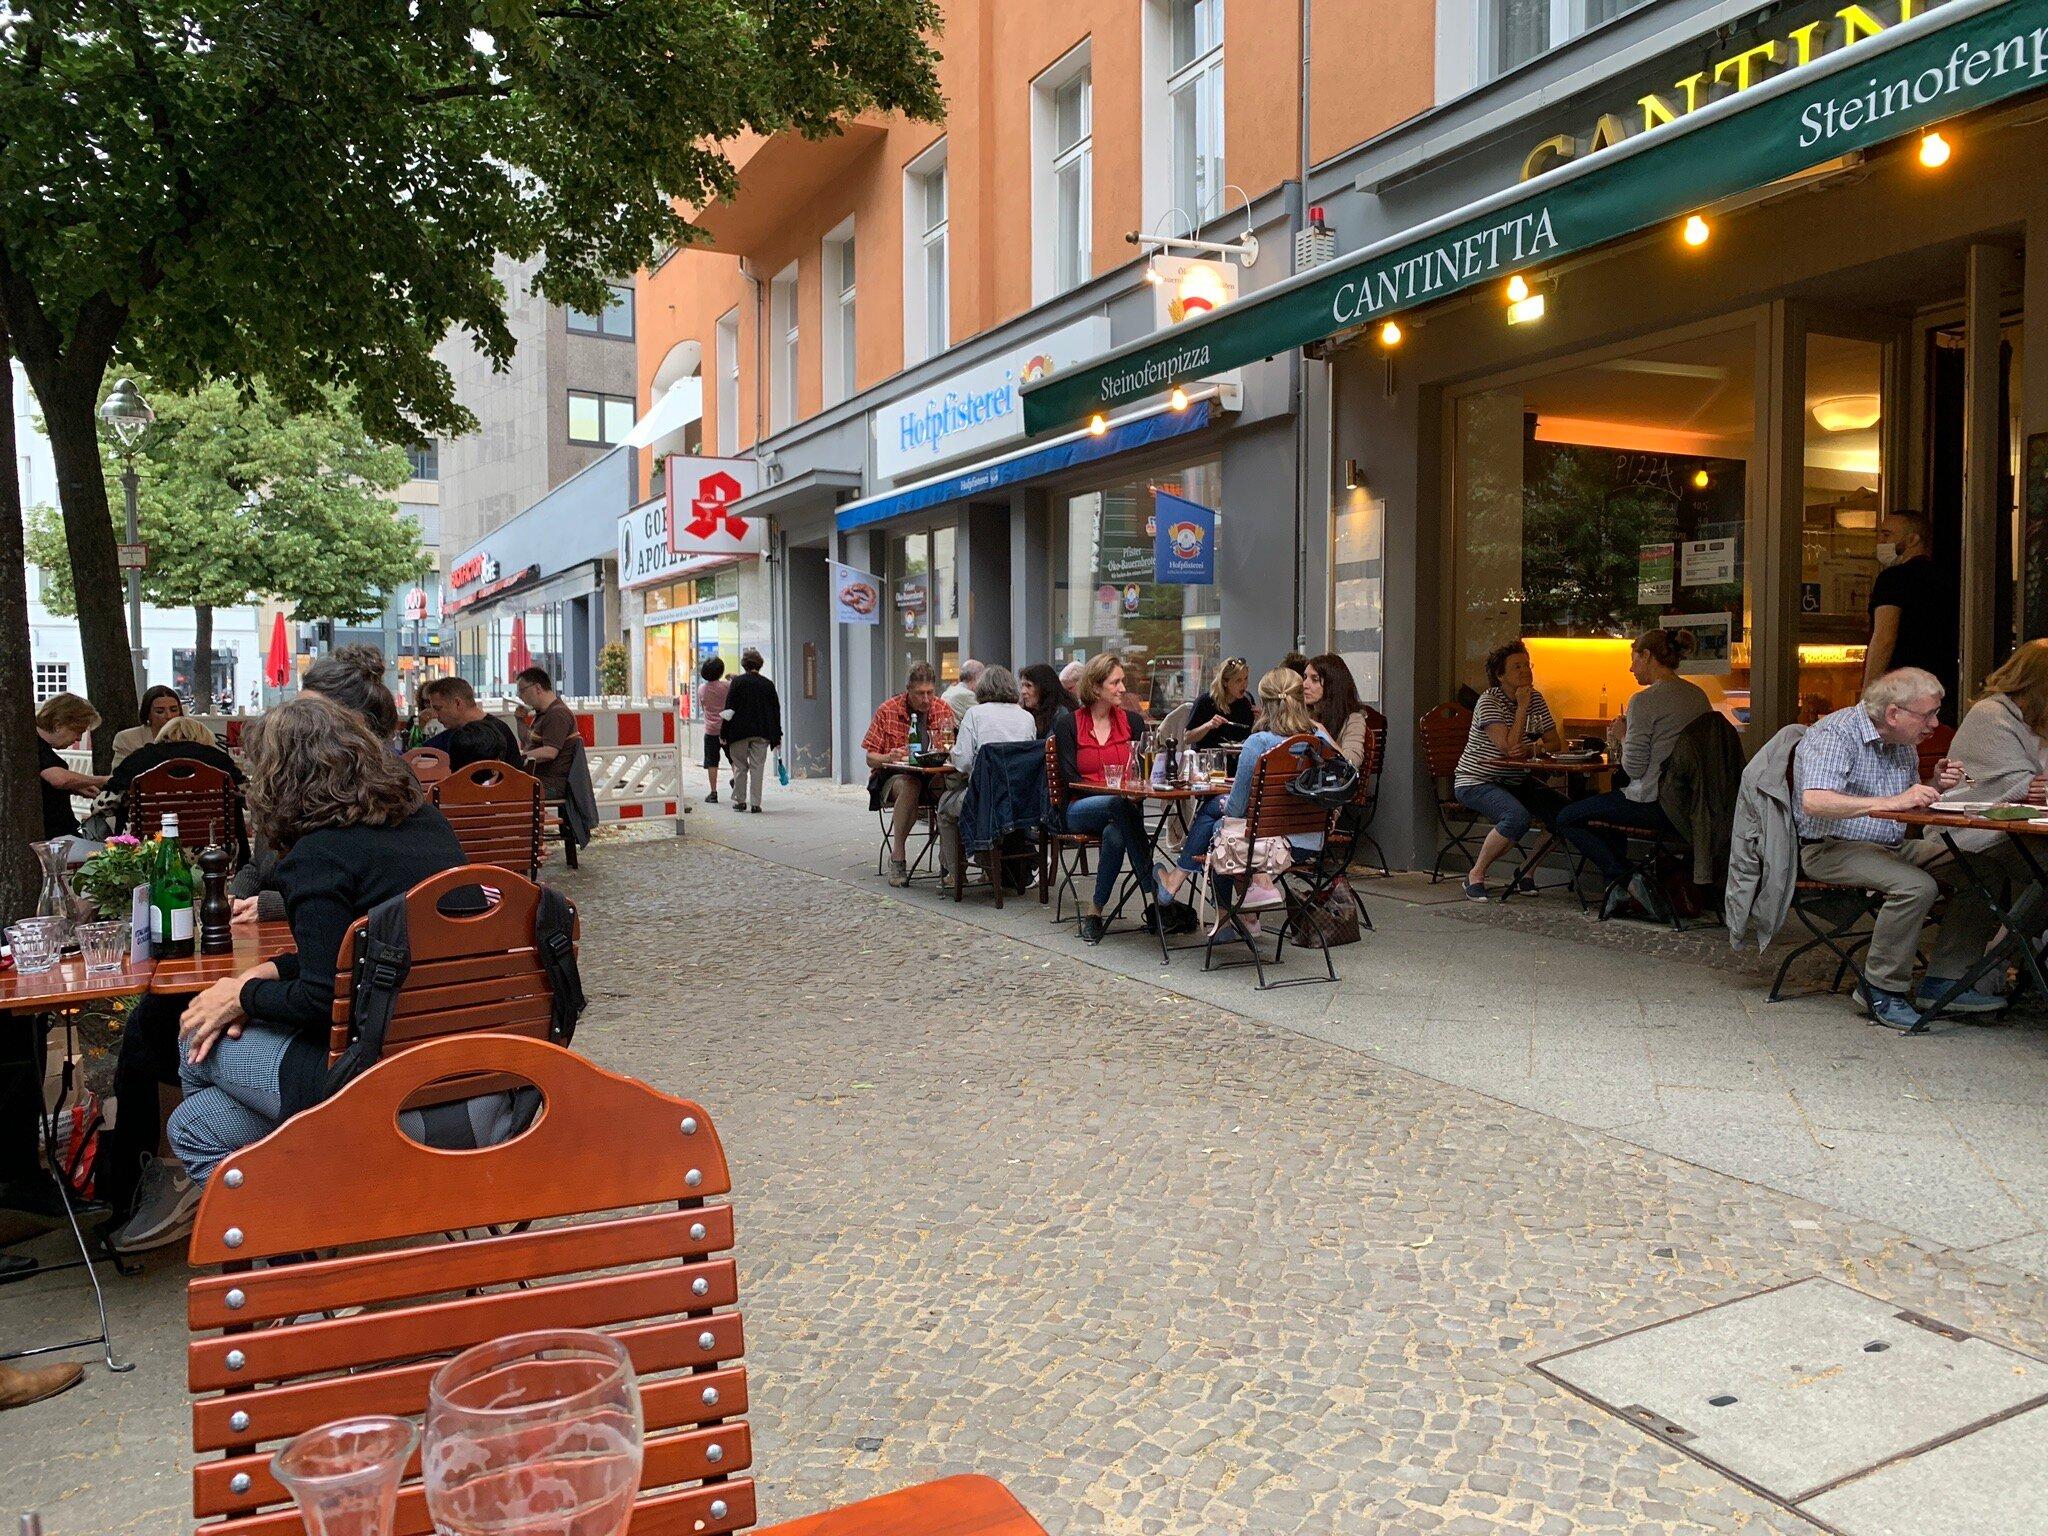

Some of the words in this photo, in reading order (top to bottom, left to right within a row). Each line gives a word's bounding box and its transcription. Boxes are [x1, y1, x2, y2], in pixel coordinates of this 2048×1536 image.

[1332, 206, 1559, 324] CANTINETTA
[1100, 344, 1211, 402] Steinofenpizza
[899, 369, 1015, 451] Hofpfisterei
[1613, 454, 1678, 494] PIZZA
